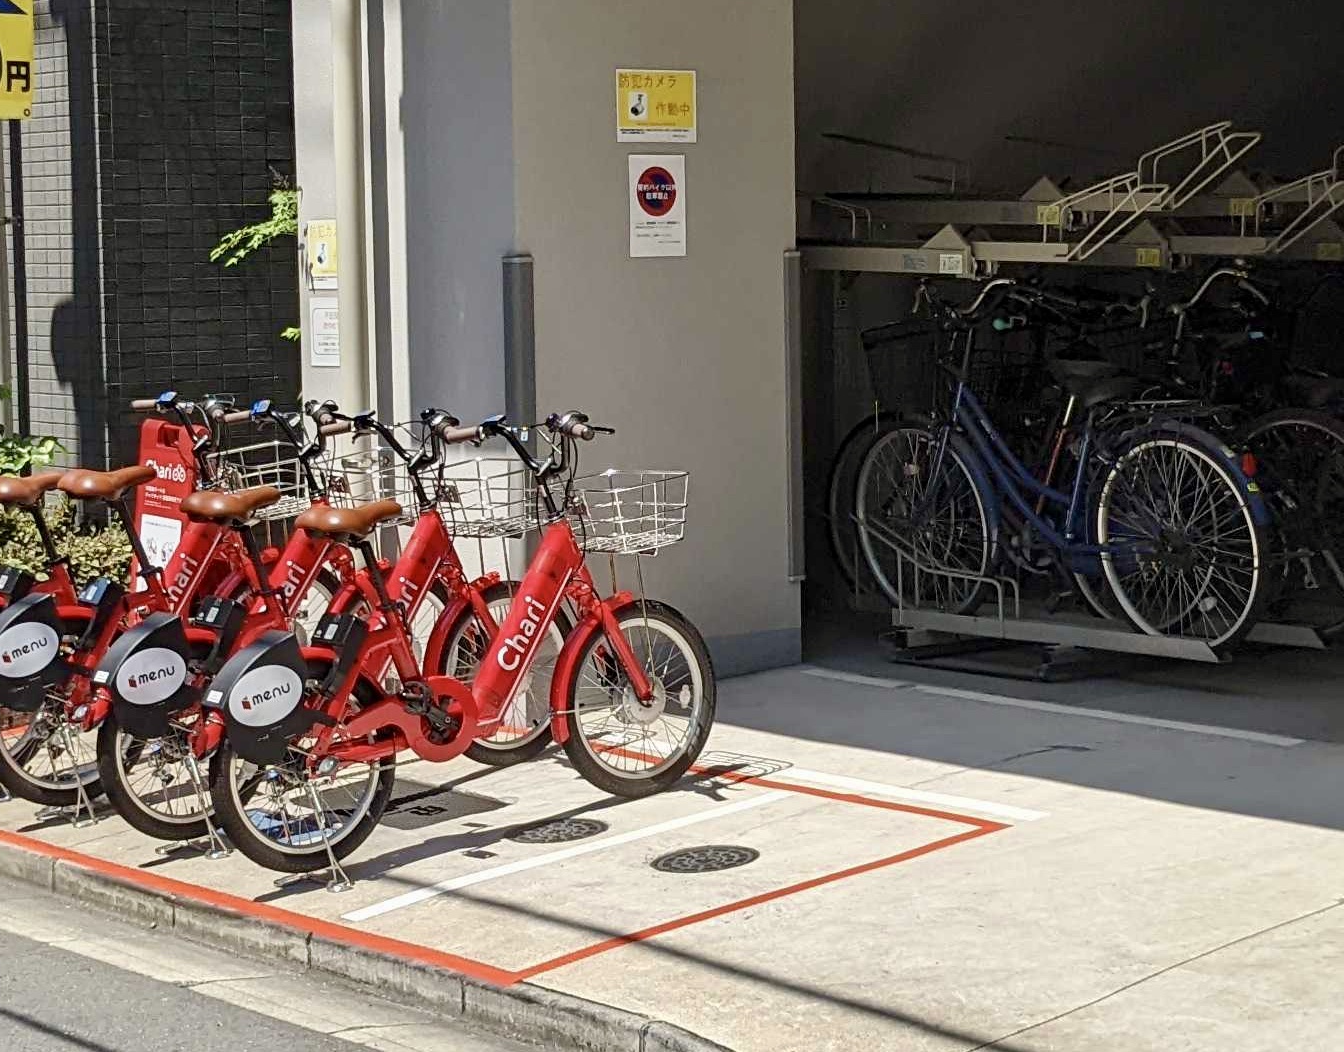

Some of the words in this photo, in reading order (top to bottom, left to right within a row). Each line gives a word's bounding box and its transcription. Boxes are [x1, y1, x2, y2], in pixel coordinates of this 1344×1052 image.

[497, 596, 546, 670] Chari
[12, 636, 48, 659] menu
[138, 665, 175, 685] menu
[252, 682, 291, 705] menu
